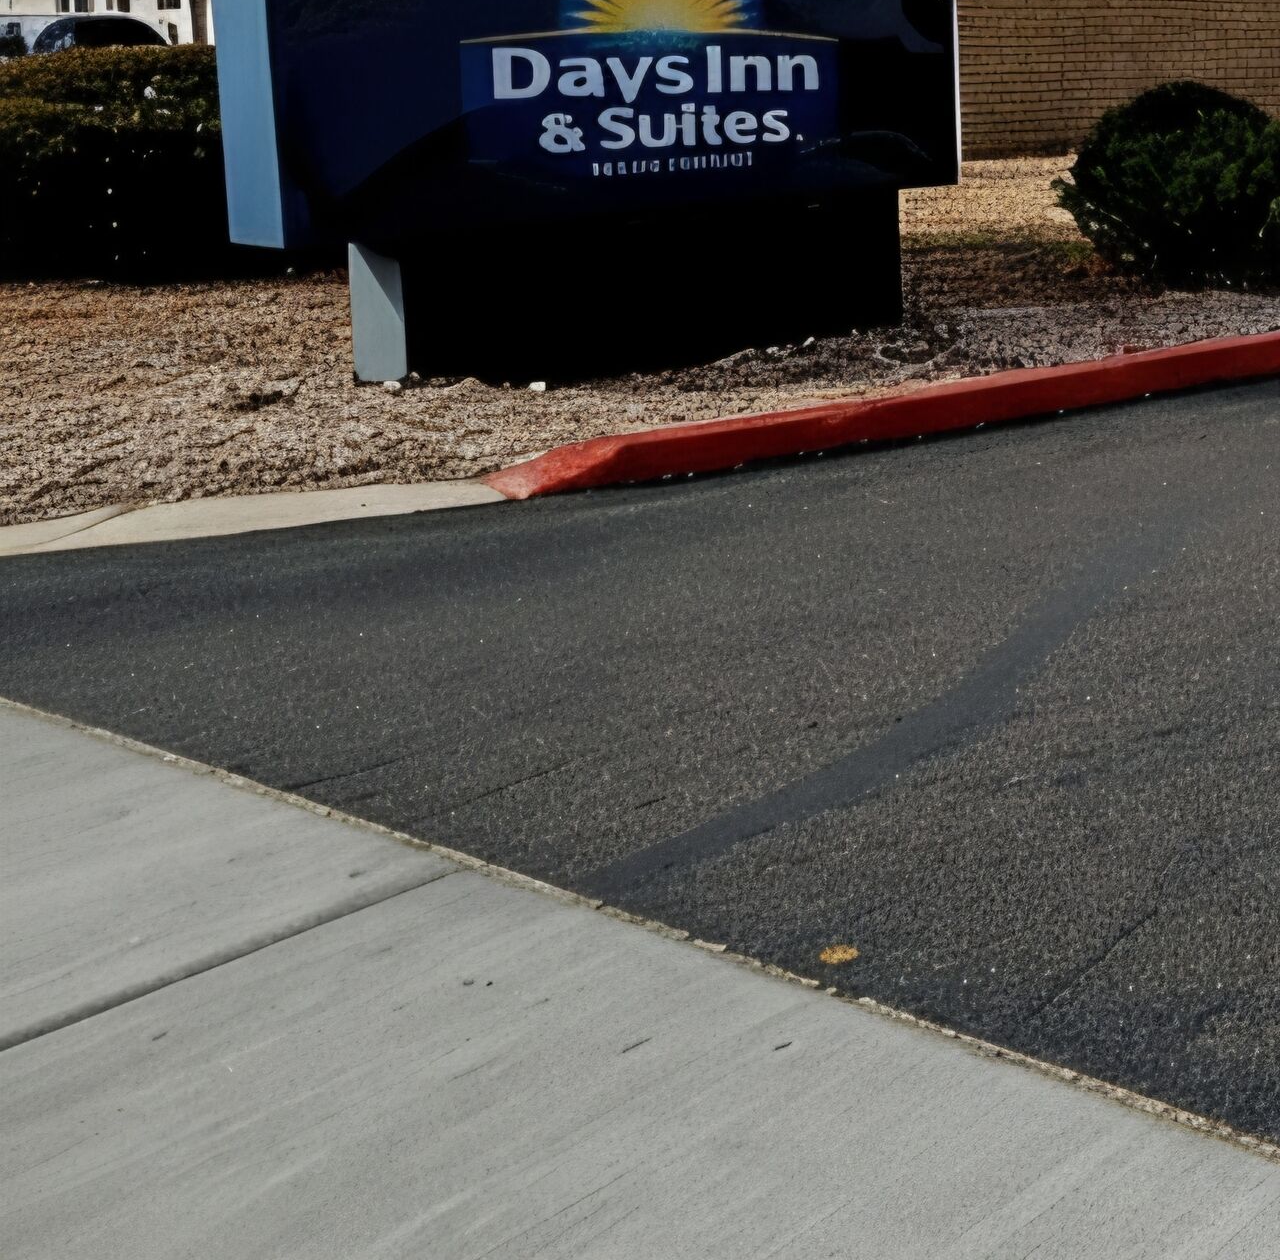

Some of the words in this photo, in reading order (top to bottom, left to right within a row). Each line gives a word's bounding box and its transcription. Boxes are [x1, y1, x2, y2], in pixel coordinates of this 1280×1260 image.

[492, 47, 694, 103] Days
[706, 45, 819, 93] Inn
[539, 113, 586, 153] &
